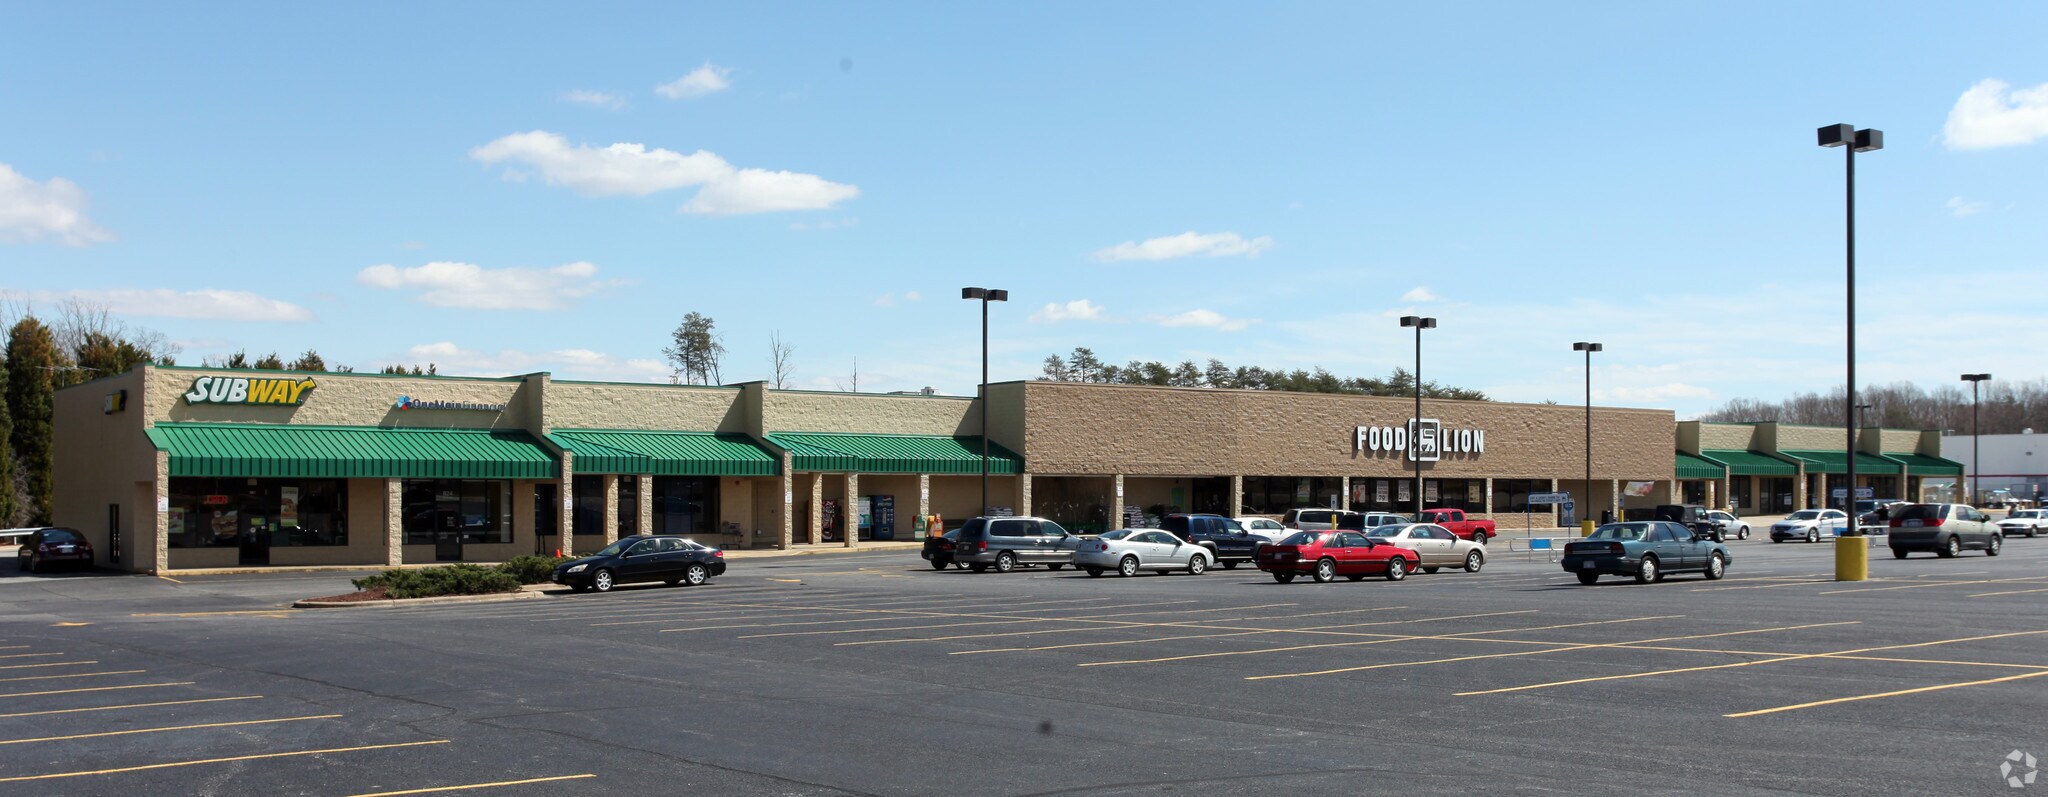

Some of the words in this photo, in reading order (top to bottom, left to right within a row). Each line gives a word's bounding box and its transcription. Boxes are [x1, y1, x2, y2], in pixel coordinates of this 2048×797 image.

[186, 376, 315, 405] SUBWAY
[1356, 426, 1407, 451] FOOD
[1442, 428, 1485, 453] LION
